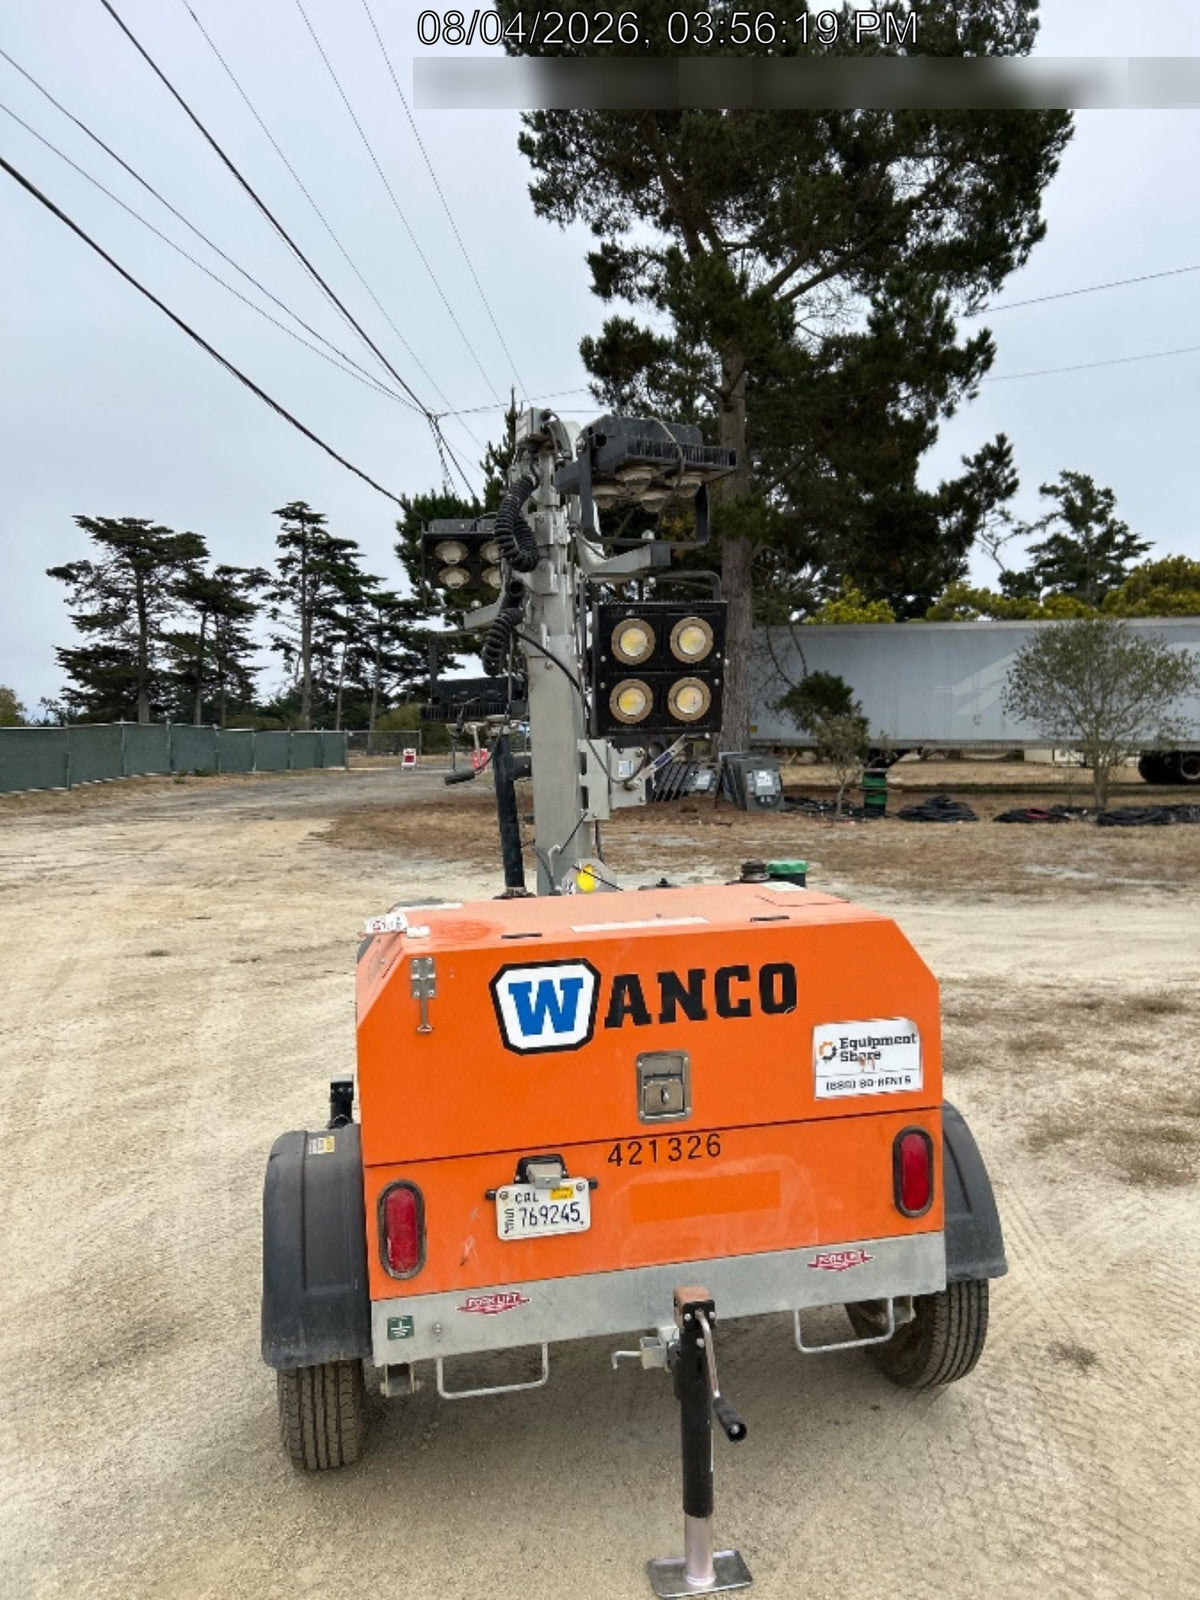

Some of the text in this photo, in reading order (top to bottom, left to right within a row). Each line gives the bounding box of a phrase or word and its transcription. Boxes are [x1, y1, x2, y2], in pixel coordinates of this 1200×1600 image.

[508, 962, 797, 1037] WANCO
[839, 1033, 917, 1049] Equipment
[608, 1133, 721, 1166] 421326
[515, 1192, 539, 1203] CAL
[519, 1202, 580, 1227] 769245
